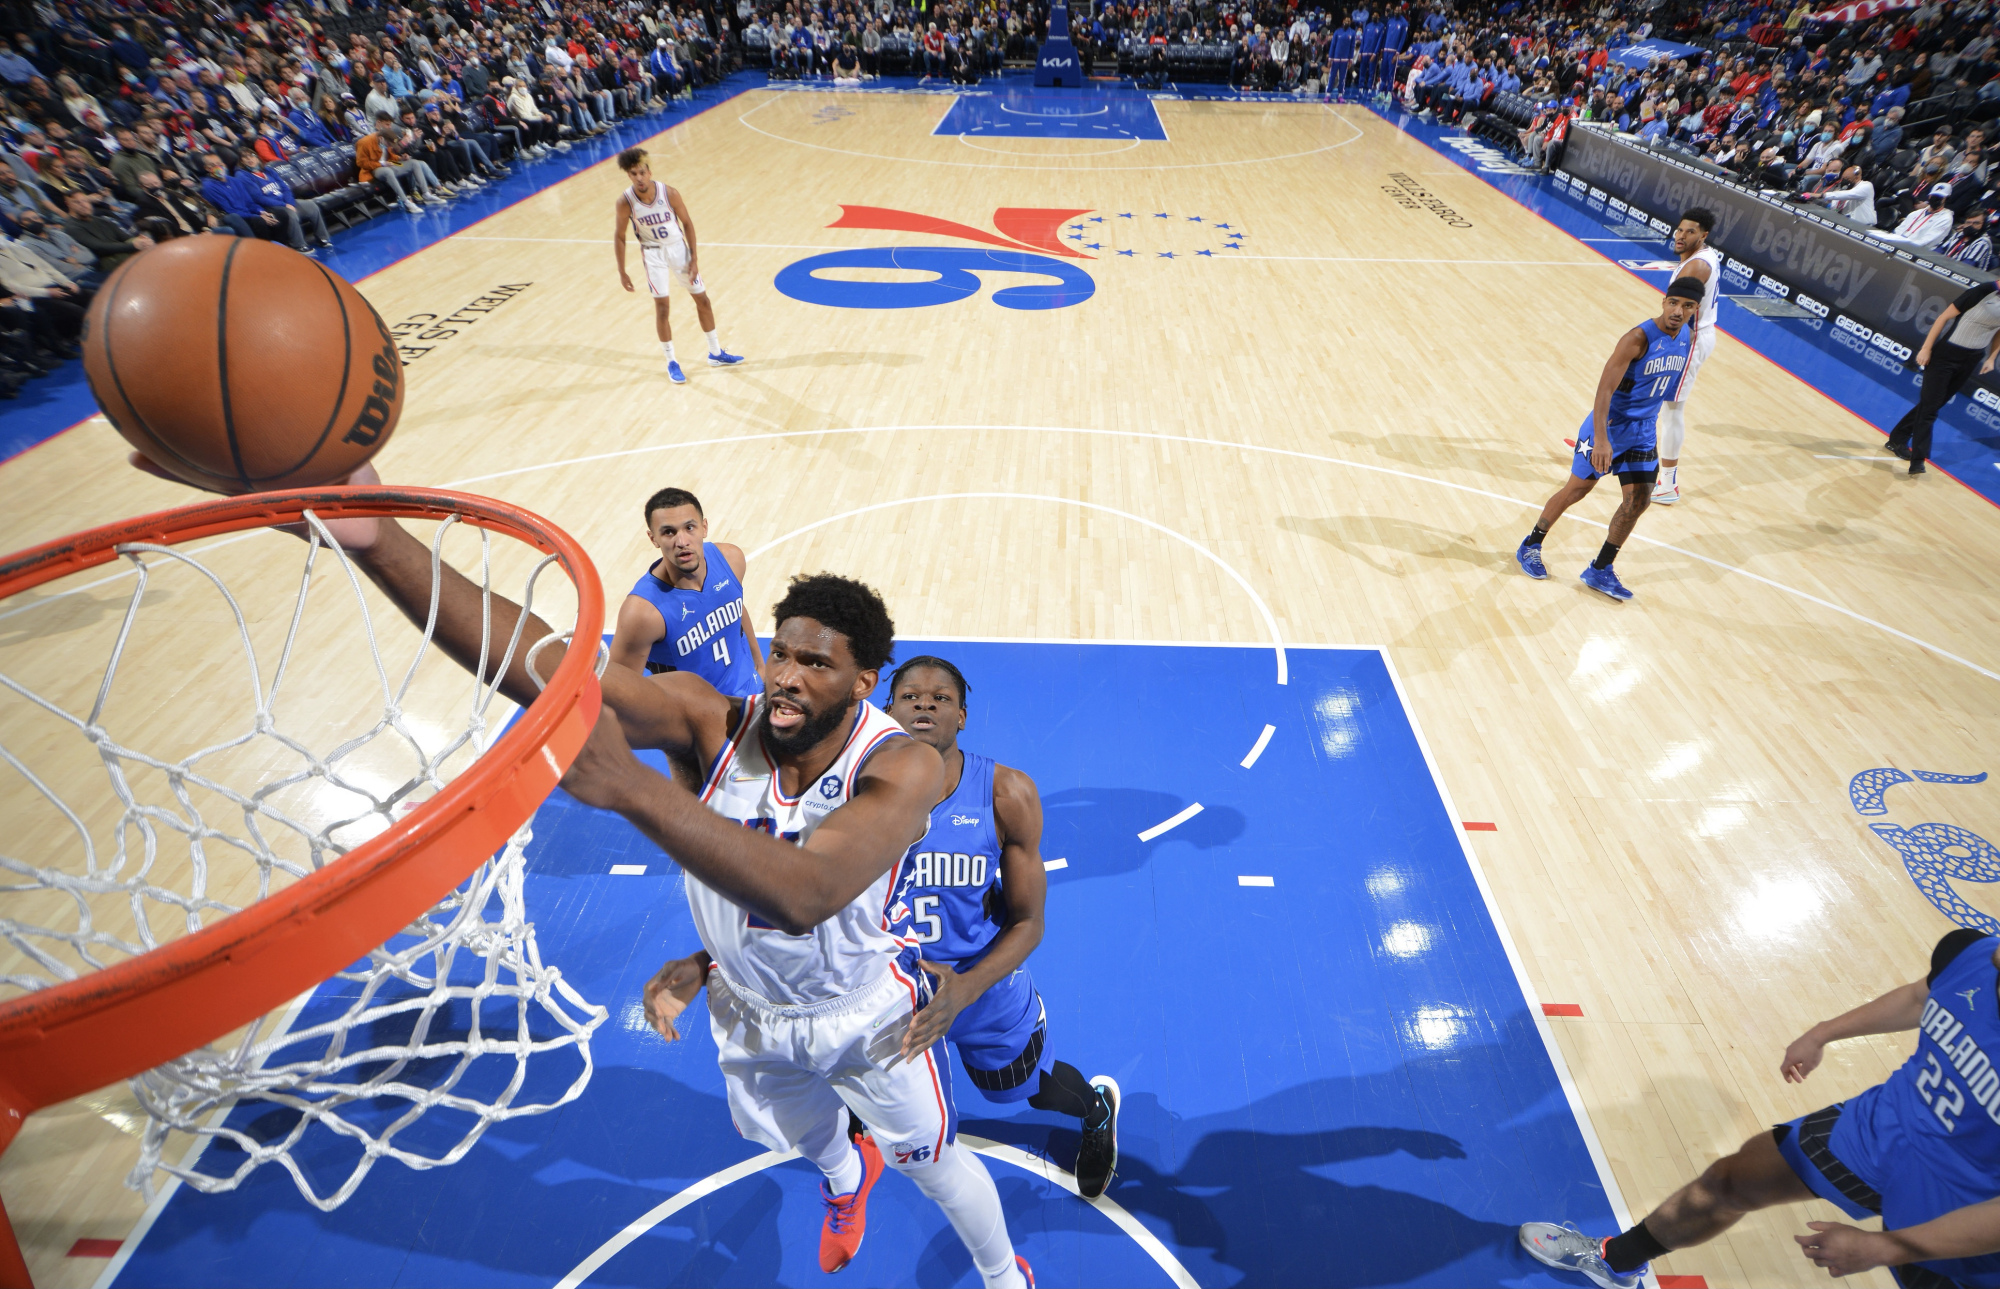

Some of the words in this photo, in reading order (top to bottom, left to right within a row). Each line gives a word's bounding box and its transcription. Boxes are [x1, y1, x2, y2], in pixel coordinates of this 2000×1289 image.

[1418, 199, 1473, 228] FARGO
[1554, 168, 1570, 183] GEICO
[1571, 177, 1587, 192] GEICO
[1590, 186, 1607, 202] GEICO
[1609, 196, 1628, 213] GEICO
[1628, 206, 1648, 223] GEICO
[1650, 218, 1671, 235] GEICO
[651, 226, 668, 240] 16
[1579, 134, 1648, 200] betway
[1752, 208, 1878, 308] betway
[1864, 236, 1880, 246] GEICO
[1879, 242, 1895, 252] GEICO
[1896, 250, 1913, 260] GEICO
[1916, 258, 1934, 268] GEICO
[1934, 265, 1951, 276] GEICO
[1951, 273, 1970, 284] GEICO
[416, 281, 534, 340] WELLS
[1726, 258, 1754, 278] GEICO
[1759, 274, 1789, 297] GEICO
[1797, 293, 1829, 318] GEICO
[1835, 314, 1872, 341] GEICO
[1871, 333, 1912, 361] GEICO
[391, 313, 437, 340] CEN
[1650, 376, 1671, 397] 14
[1973, 388, 2000, 412] GEI
[713, 579, 729, 592] Disney
[676, 597, 743, 657] ORLANDO
[712, 637, 732, 667] 4
[805, 800, 837, 812] crypto.c
[950, 815, 980, 827] Disney
[914, 852, 987, 888] ANDO
[914, 895, 942, 944] 5
[1916, 1051, 1965, 1133] 22
[893, 1143, 931, 1164] 76
